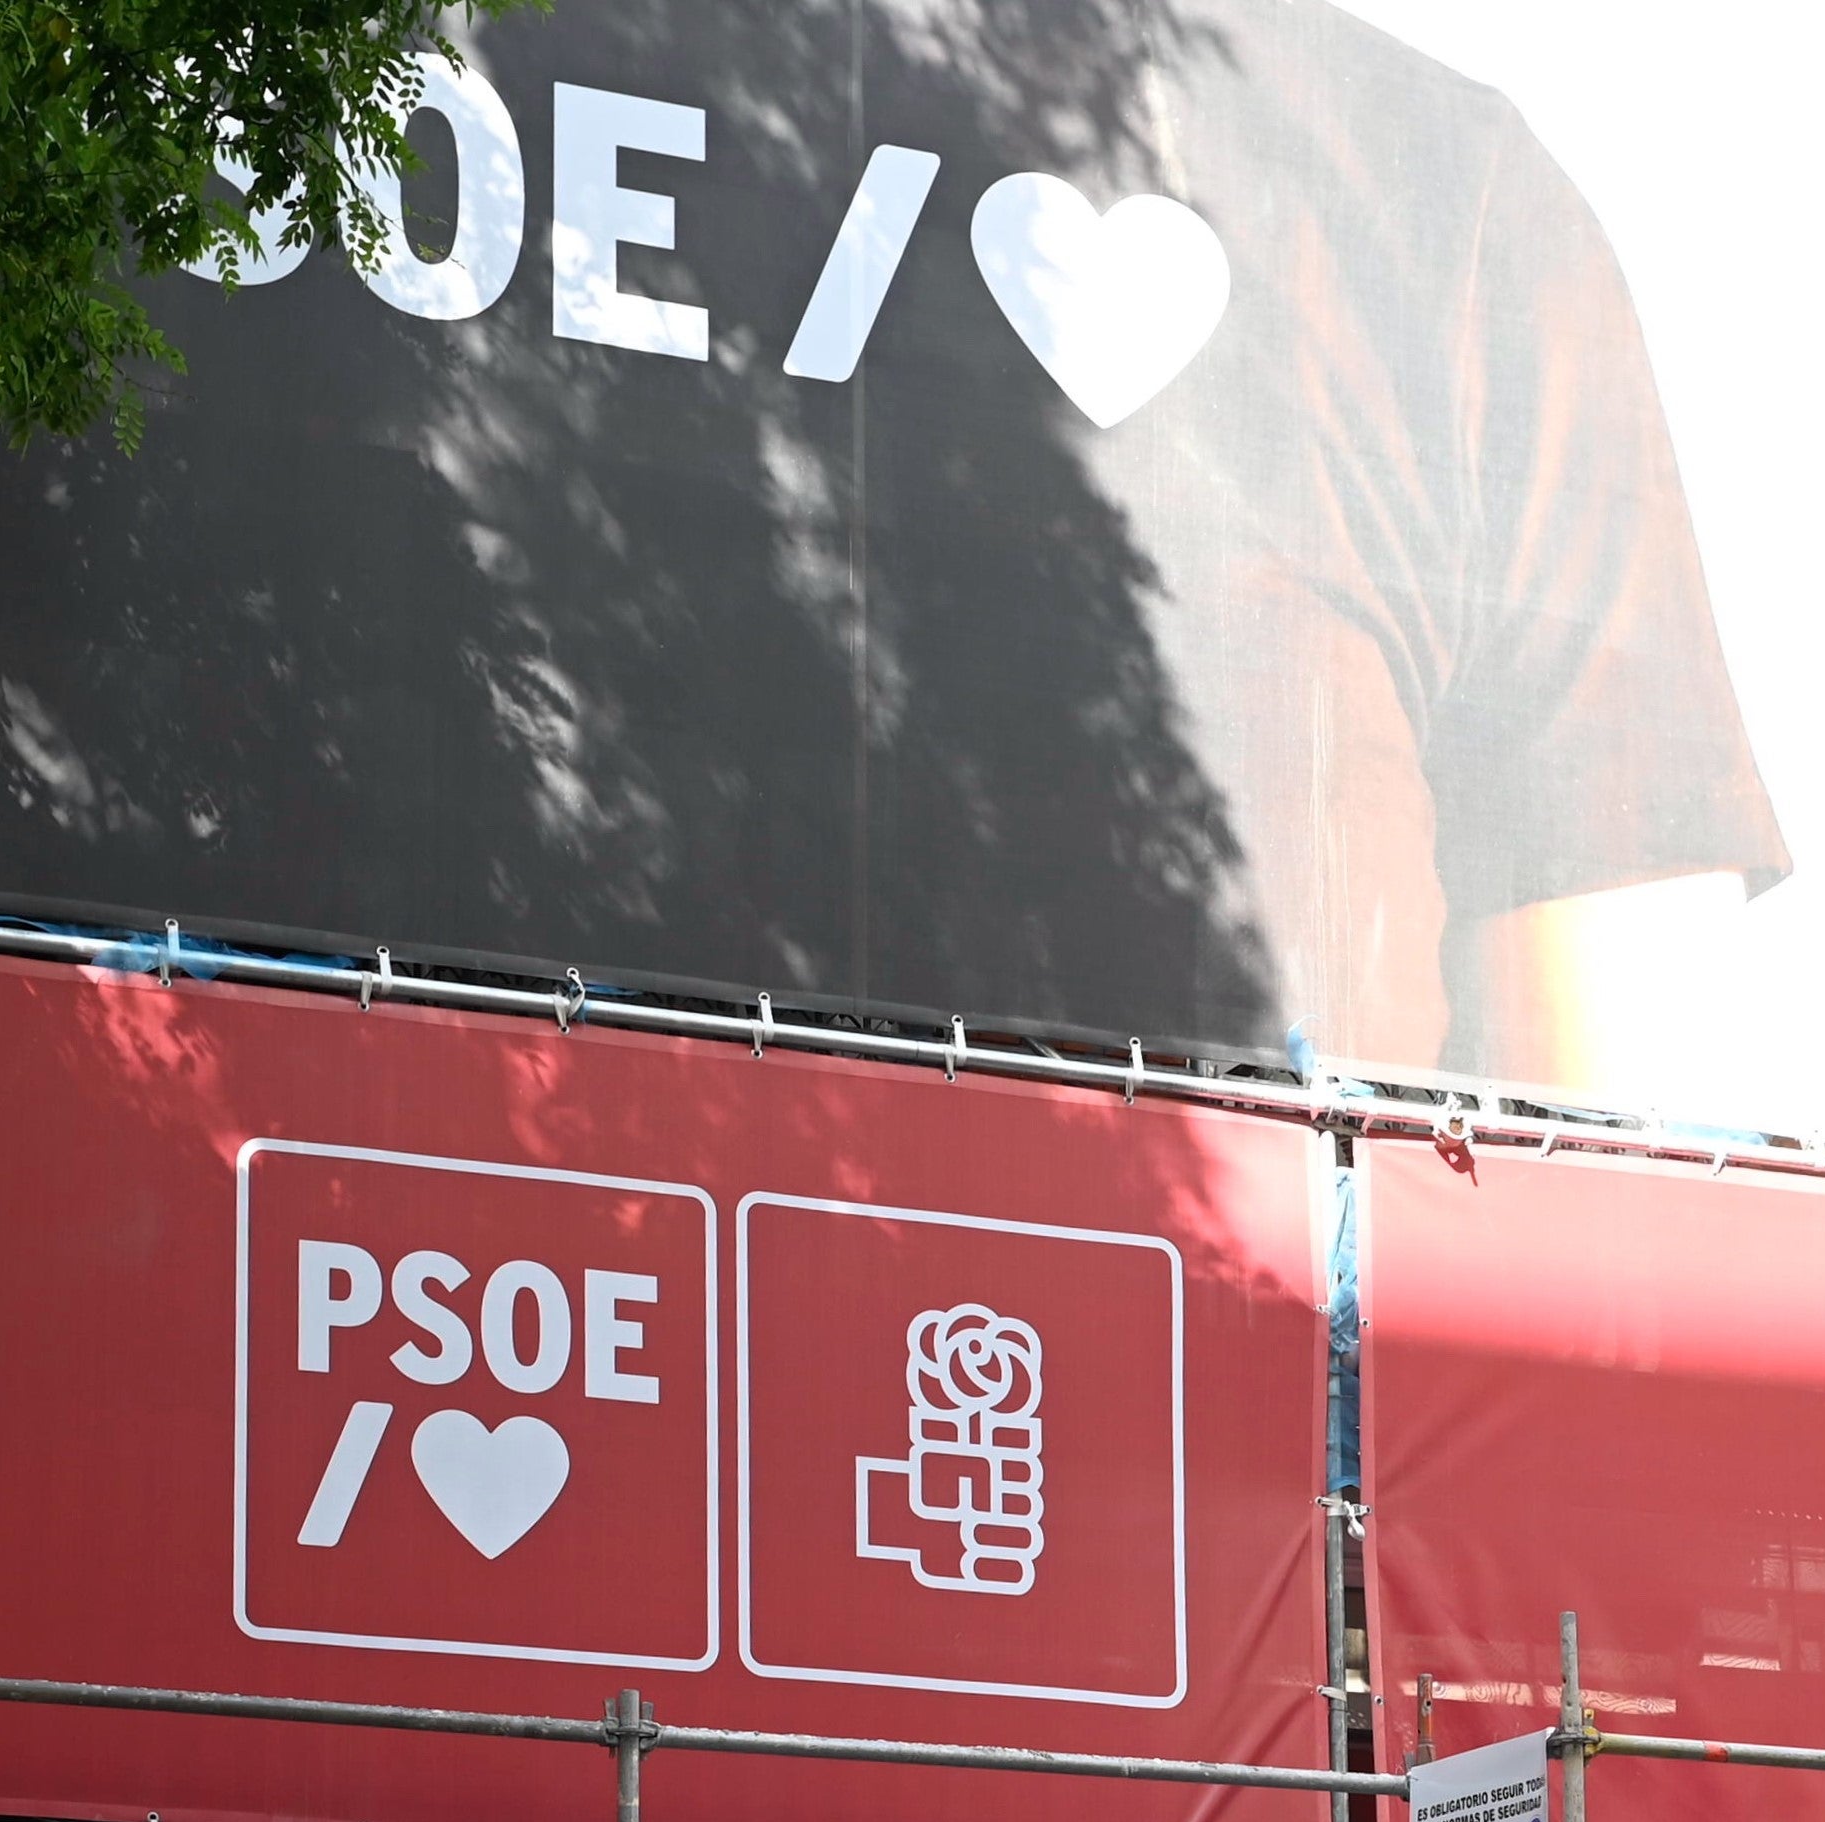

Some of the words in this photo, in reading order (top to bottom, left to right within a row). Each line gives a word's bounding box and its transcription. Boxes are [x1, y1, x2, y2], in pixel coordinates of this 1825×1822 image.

[297, 1238, 660, 1404] PSOE
[1417, 1807, 1428, 1821] ES
[1429, 1792, 1489, 1819] OBLIGATORIO
[1491, 1783, 1524, 1803] SEGUIR
[1483, 1809, 1495, 1822] DE
